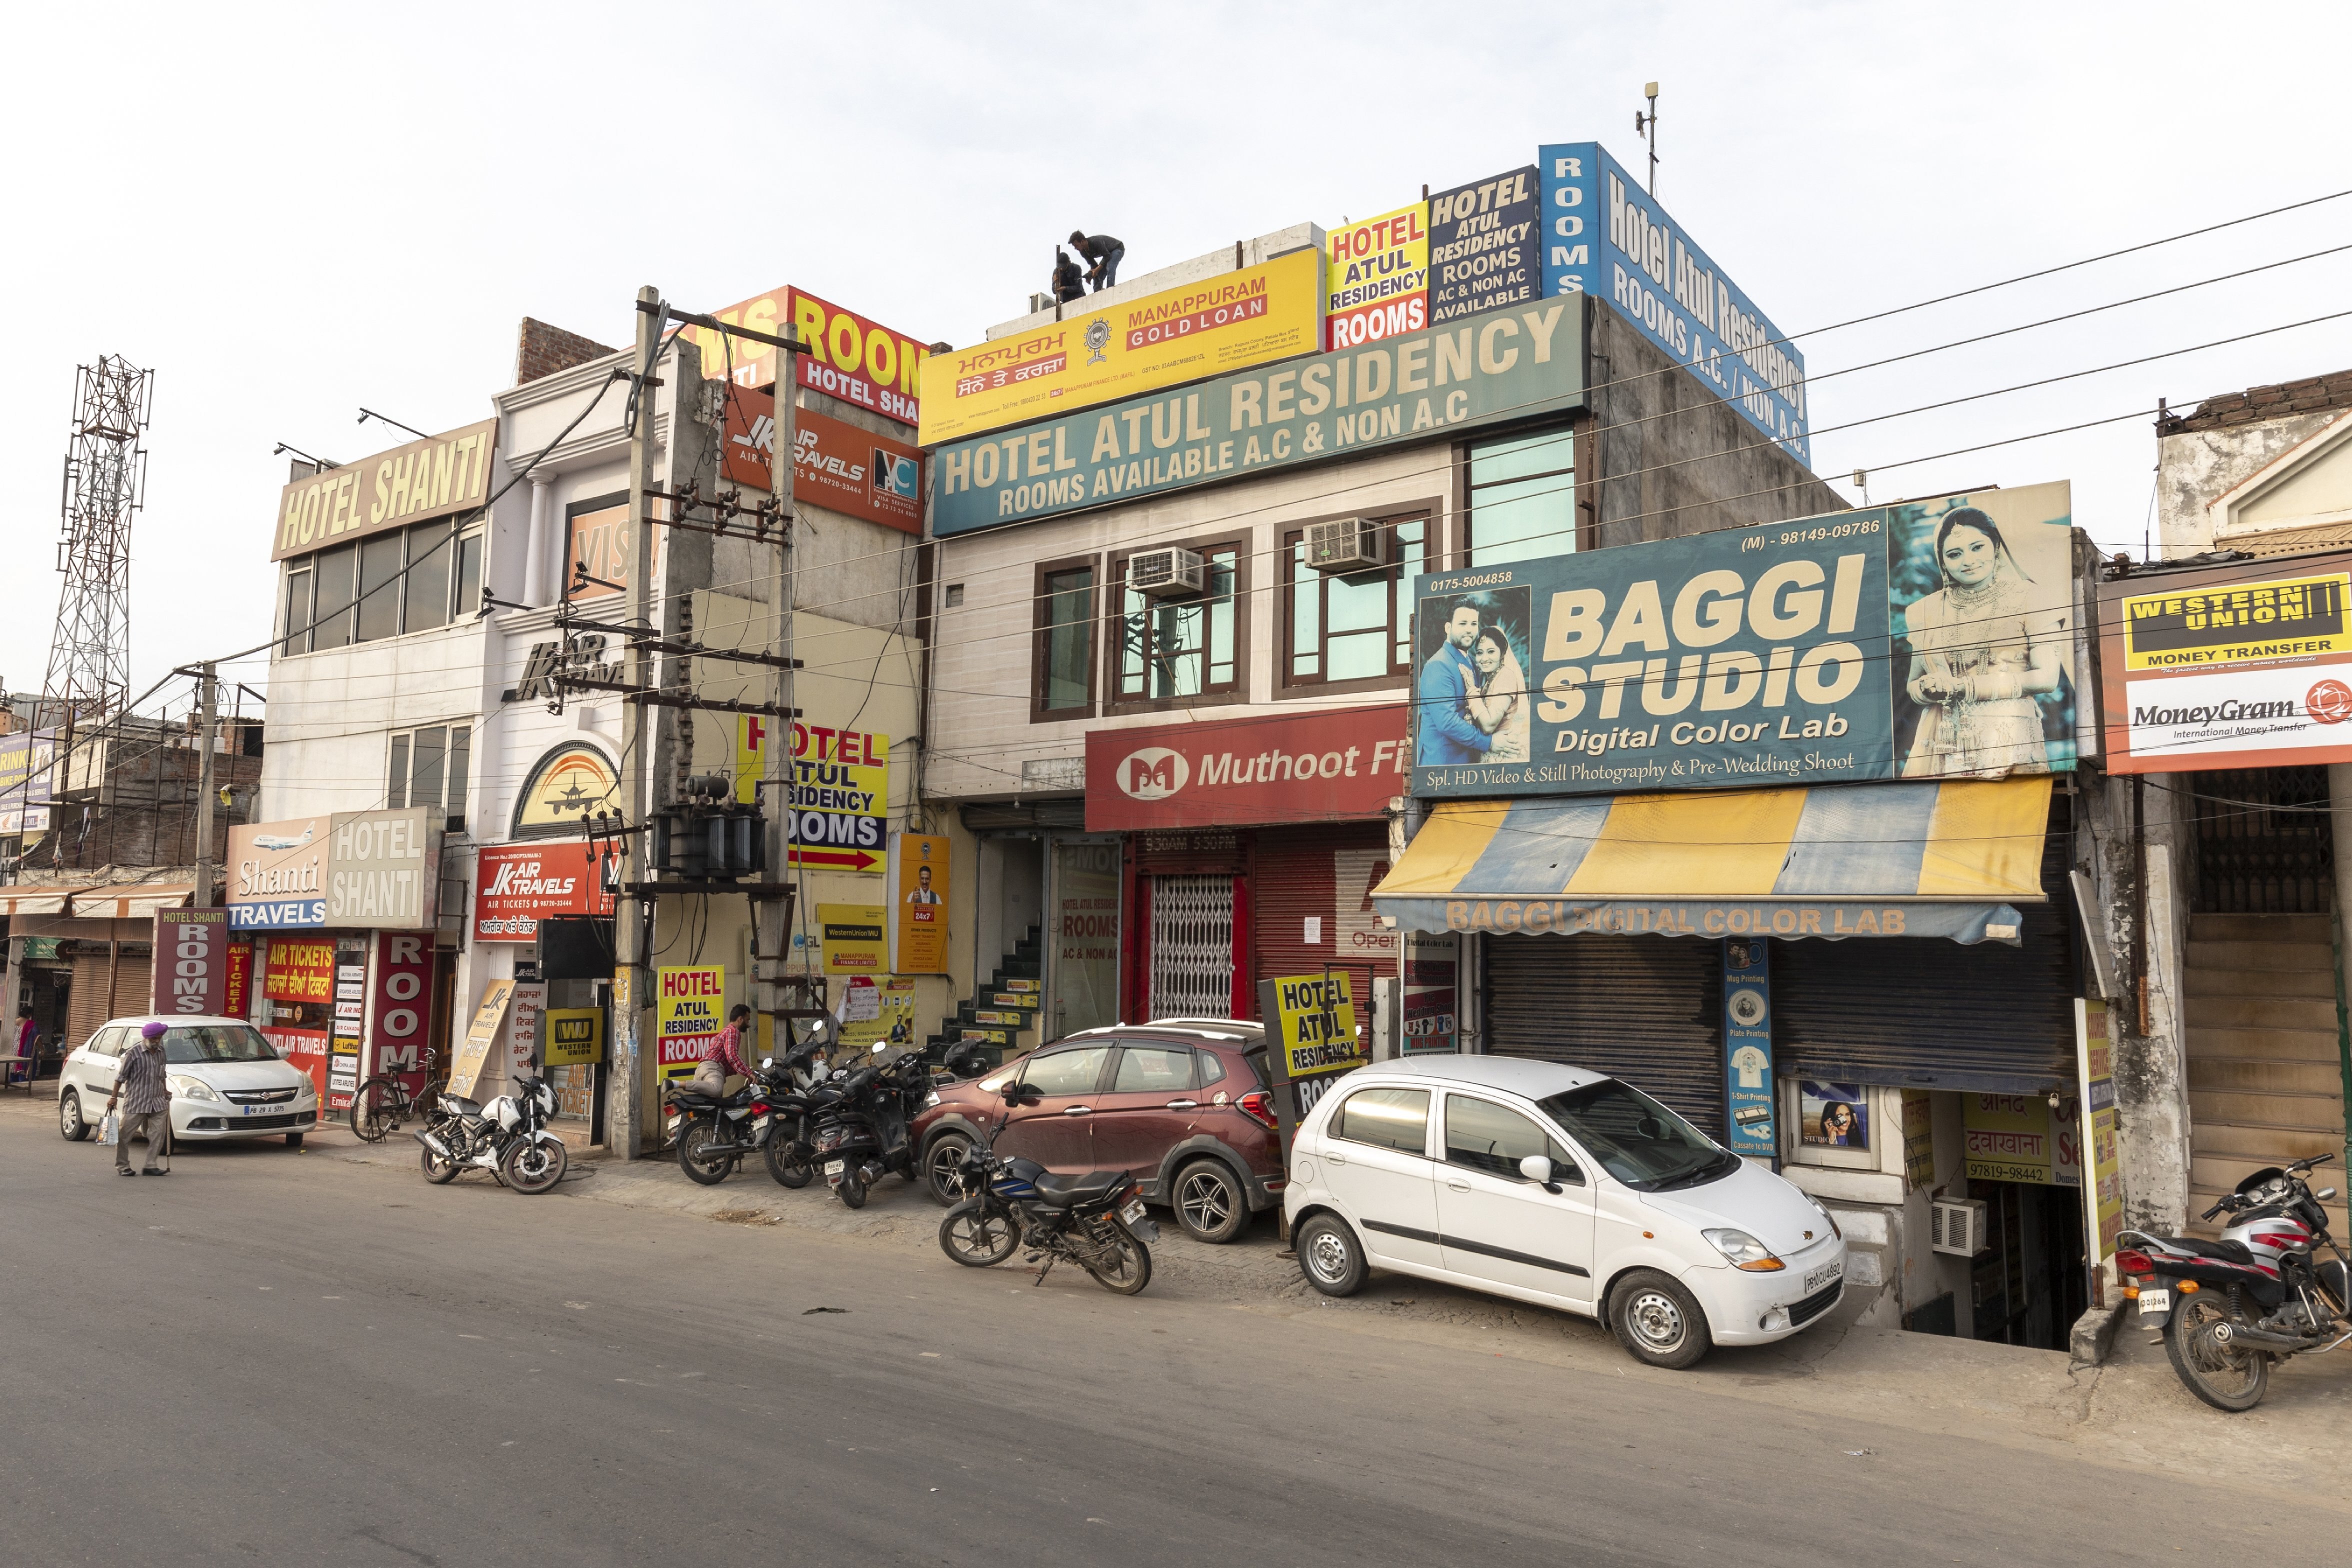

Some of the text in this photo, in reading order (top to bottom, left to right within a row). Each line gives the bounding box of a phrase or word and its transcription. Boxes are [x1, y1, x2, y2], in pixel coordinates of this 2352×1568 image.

[1431, 172, 1529, 228] HOTEL
[1333, 212, 1425, 264] HOTEL
[1456, 210, 1501, 238] ATUL
[1551, 158, 1589, 295] ROOMS
[1432, 221, 1531, 264] RESIDENCY
[1344, 249, 1412, 286] ATUL
[1443, 246, 1521, 284] ROOMS
[1330, 268, 1427, 311] RESIDENCY
[1437, 268, 1525, 304] AC & NON AC
[1608, 170, 1804, 422] Hotel Atul Residency
[1129, 276, 1266, 329] MANAPPURAM
[1433, 286, 1530, 322] AVAILABLE
[1131, 319, 1190, 346] GOLD
[1201, 294, 1263, 329] LOAN
[1333, 298, 1424, 350] ROOMS
[1613, 261, 1775, 430] ROOMS NON
[807, 362, 874, 406] HOTEL
[1065, 378, 1110, 393] MANAPPURAM FINANCE
[945, 304, 1565, 496] HOTEL ATUL RESIDENCY
[740, 450, 757, 464] AIR
[1000, 390, 1468, 516] ROOMS AVAILABLE A.C & NON A.C
[281, 431, 488, 551] HOTEL SHANTI
[877, 494, 914, 510] VISA SERVICES
[1741, 520, 1880, 552] (M) 98149-09786
[1431, 571, 1512, 592] 0175-5004858
[1542, 552, 1865, 662] BAGGI
[2132, 585, 2303, 620] WESTERN
[2186, 604, 2304, 630] UNION
[2147, 640, 2332, 666] MONEY TRANSFER
[2175, 664, 2198, 674] fastest
[2278, 655, 2316, 663] worldwide
[1537, 641, 1864, 724] STUDIO
[2133, 700, 2293, 727] MoneyGram
[1554, 712, 1849, 756] Digital Color Lab
[2173, 722, 2306, 738] International Money Transfer
[1197, 744, 1360, 786] Muthoot
[1427, 752, 1855, 791] Spl. HD Video & Still Photography & Pre-Wedding Shoot
[336, 818, 421, 861] HOTEL
[239, 854, 320, 896] Shanti
[515, 862, 541, 878] AIR
[331, 870, 419, 918] SHANTI
[510, 878, 576, 895] TRAVELS
[163, 912, 224, 922] HOTEL SHANTI
[229, 902, 326, 926] TRAVELS
[488, 900, 498, 908] AIR
[503, 900, 530, 908] TICKETS
[1062, 898, 1093, 910] HOTEL ATUL
[1446, 900, 1906, 934] BAGGI COLOR LAB
[229, 946, 249, 954] AIR
[269, 944, 332, 968] AIR TICKETS
[1063, 948, 1106, 960] AC NON
[1442, 940, 1453, 948] Lab
[174, 924, 210, 1013] ROOMS
[1727, 975, 1764, 984] Mug Printing
[663, 970, 721, 998] HOTEL
[1283, 978, 1349, 1010] HOTEL
[473, 1020, 496, 1028] TRAVELS
[673, 1002, 711, 1017] ATUL
[1407, 1006, 1435, 1020] Wedding
[665, 1017, 719, 1034] RESIDENCY
[1746, 1030, 1769, 1039] Printing
[1410, 1036, 1450, 1049] MUG PRINTING
[1750, 1094, 1771, 1103] Printing
[1804, 1135, 1830, 1143] STUDIO
[1967, 1130, 2043, 1156] दवाखाना
